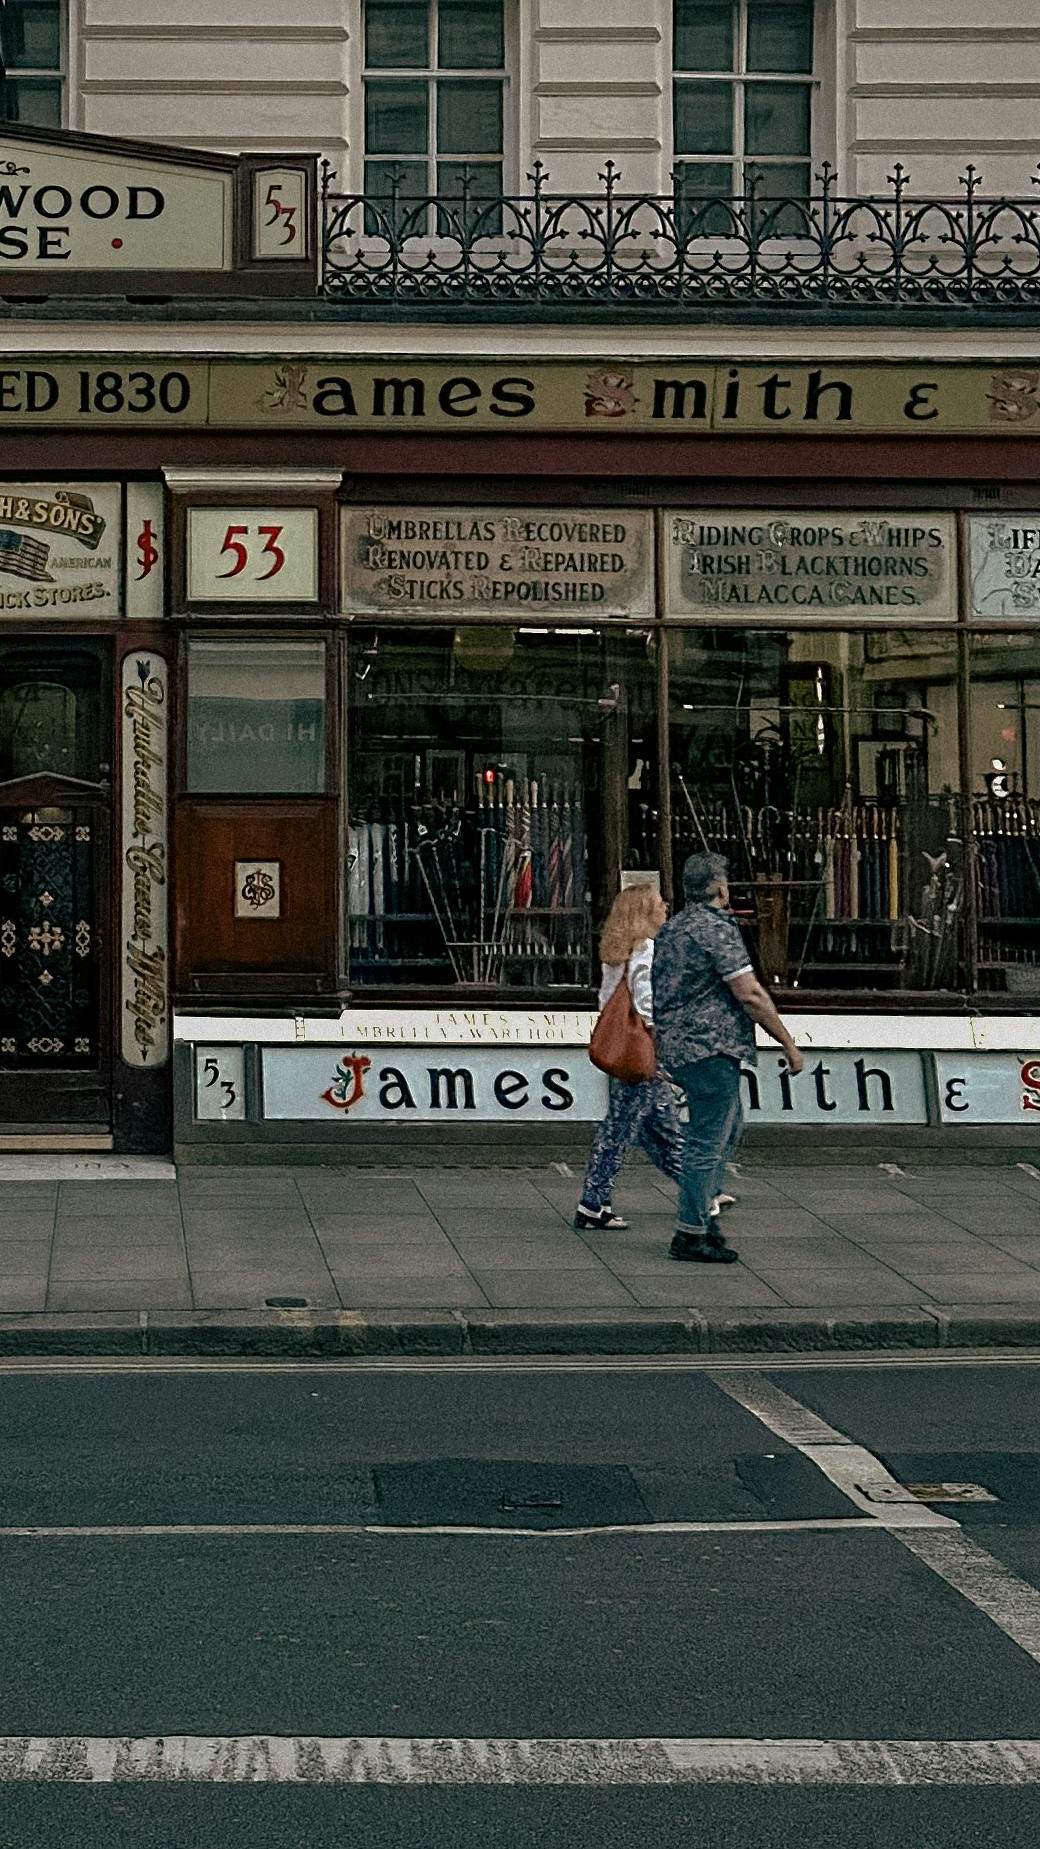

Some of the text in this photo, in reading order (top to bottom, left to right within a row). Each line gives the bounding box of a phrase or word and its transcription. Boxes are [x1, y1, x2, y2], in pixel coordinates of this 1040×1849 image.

[265, 185, 297, 245] 53
[80, 371, 191, 414] 1830
[259, 364, 535, 418] James
[584, 366, 853, 420] Smith
[14, 497, 31, 521] &
[366, 515, 626, 543] UMBRELLAS RECOVERED
[672, 519, 762, 546] RIDING
[768, 520, 843, 547] CROPS
[49, 556, 111, 569] AMERICAN
[215, 526, 285, 581] 53
[365, 543, 489, 571] RENOVATED
[688, 550, 750, 575] IRISH
[386, 574, 604, 601] STICKS REPOLISHED
[700, 578, 823, 604] MALACCA
[203, 1058, 236, 1108] 53
[321, 1051, 574, 1113] James
[740, 1058, 894, 1112] ith
